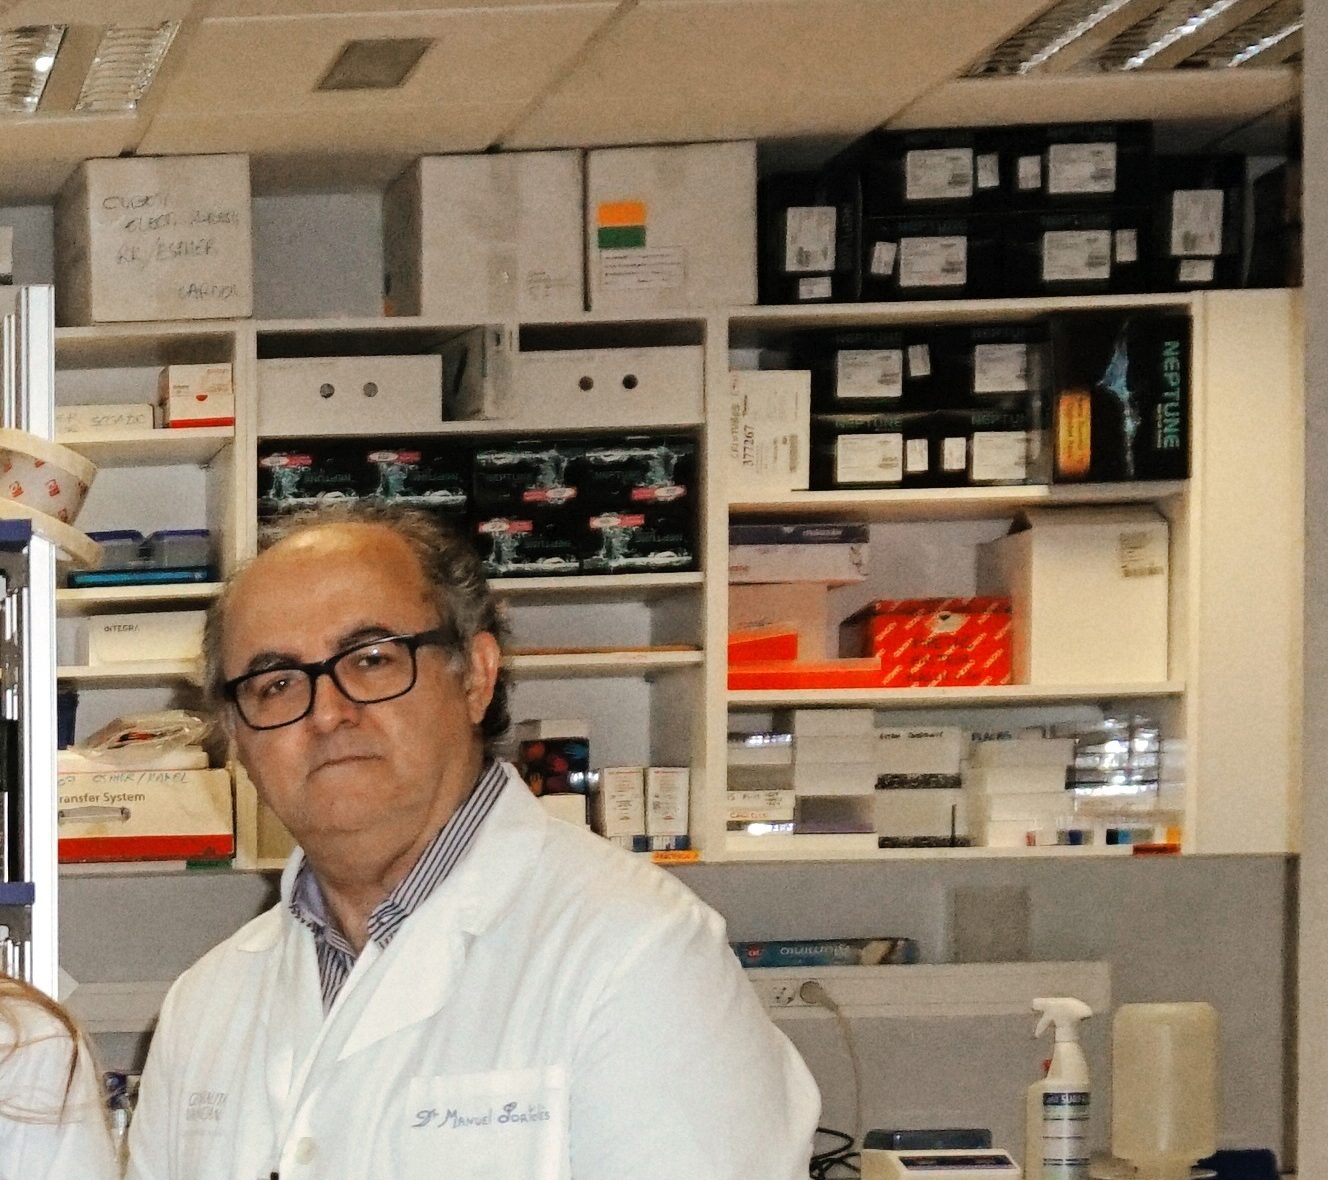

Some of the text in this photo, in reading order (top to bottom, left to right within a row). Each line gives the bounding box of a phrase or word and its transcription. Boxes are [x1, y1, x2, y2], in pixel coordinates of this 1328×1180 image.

[1163, 340, 1181, 448] NEPTUNE
[59, 791, 146, 807] ransfer System
